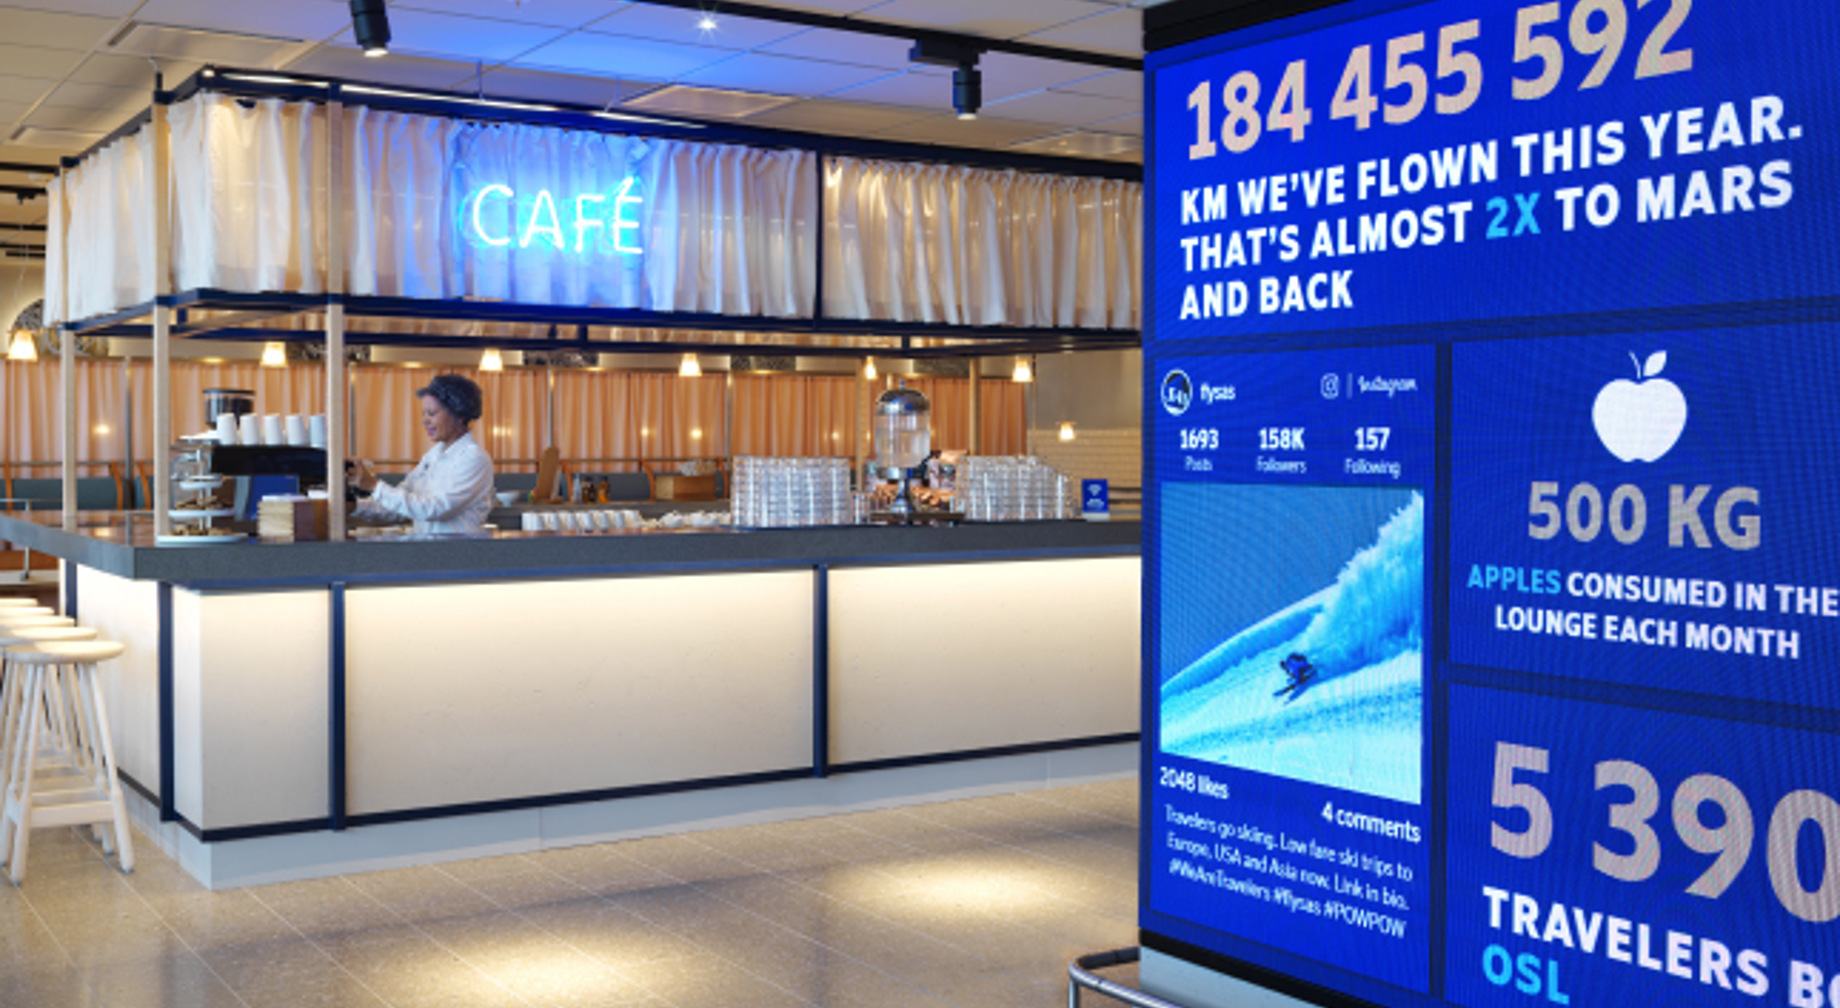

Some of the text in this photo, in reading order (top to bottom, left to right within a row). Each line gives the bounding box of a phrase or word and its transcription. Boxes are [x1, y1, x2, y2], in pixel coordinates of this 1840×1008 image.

[1187, 0, 1693, 160] 184 455 592
[1181, 94, 1803, 225] KM WE'VE FLOWN THIS YEAR.
[472, 175, 644, 255] CAFÉ
[1181, 159, 1793, 272] THAT'S ALMOST 2X TO MARS
[1180, 269, 1353, 320] AND BACK
[1200, 382, 1236, 406] flysas
[1180, 428, 1219, 449] 1693
[1185, 456, 1213, 472] Posts
[1258, 427, 1306, 450] 158K
[1355, 426, 1391, 450] 157
[1256, 456, 1307, 474] Followers
[1345, 457, 1401, 480] Following
[1528, 481, 1762, 551] 500 KG
[1466, 564, 1840, 617] APPLES CONSUMED IN THE
[1495, 604, 1799, 660] LOUNGE EACH MONTH
[1159, 766, 1229, 800] 2048 likes
[1165, 803, 1413, 882] Travelers go skiing. Low fare ski trips to
[1320, 801, 1421, 844] 4 comments
[1491, 741, 1840, 924] 5 390
[1166, 830, 1213, 860] Europe,
[1214, 843, 1242, 867] USA
[1243, 855, 1268, 873] and
[1269, 857, 1298, 881] Asia
[1334, 872, 1364, 899] Link
[1366, 883, 1379, 902] in
[1272, 886, 1321, 916] #flysas
[1323, 899, 1407, 939] #POWPOW
[1482, 885, 1770, 997] TRAVELERS
[1482, 943, 1570, 1006] OSL
